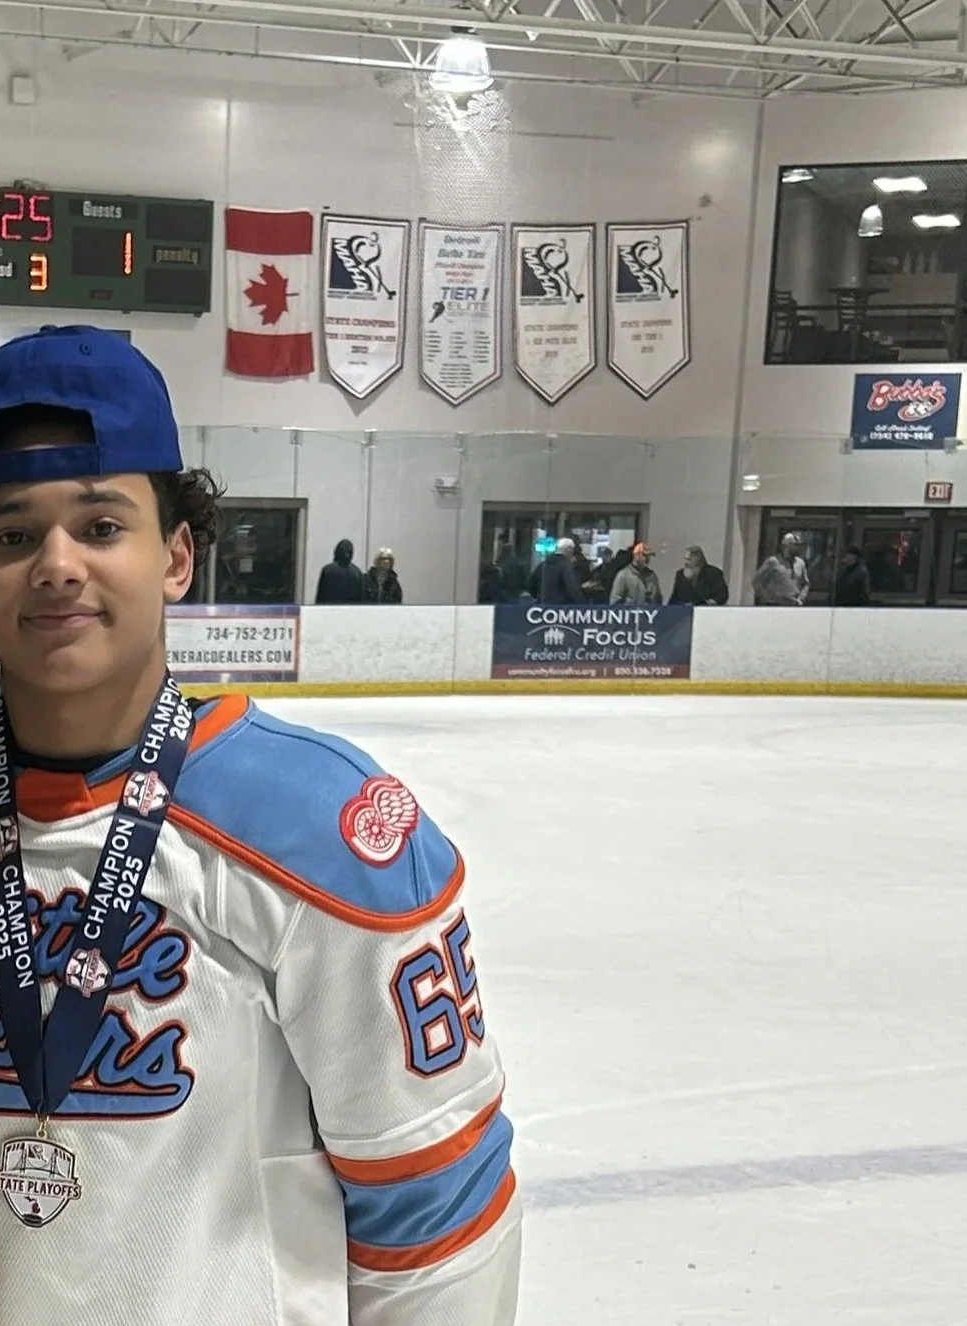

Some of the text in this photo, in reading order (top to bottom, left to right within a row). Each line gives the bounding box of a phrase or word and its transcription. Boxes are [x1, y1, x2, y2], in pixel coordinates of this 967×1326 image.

[82, 200, 122, 219] Guests
[124, 231, 132, 275] 1
[29, 254, 48, 292] 3
[333, 237, 369, 292] MAHA
[523, 247, 558, 298] MAHA
[618, 245, 654, 294] MAHA
[441, 286, 478, 301] TIER
[446, 301, 490, 312] ELITE
[927, 483, 951, 499] EXIT
[526, 607, 659, 625] COMMUNITY
[205, 627, 293, 641] 734-752-2171
[583, 628, 656, 646] FOCUS
[165, 650, 292, 664] ENERACDEALERS.COM
[524, 647, 657, 661] Federal Credit Union
[83, 818, 136, 940] CHAMPION
[112, 856, 144, 914] 2025
[2, 865, 35, 989] CHAMPION
[389, 907, 485, 1080] 65
[27, 1181, 80, 1198] PLAYOFFS
